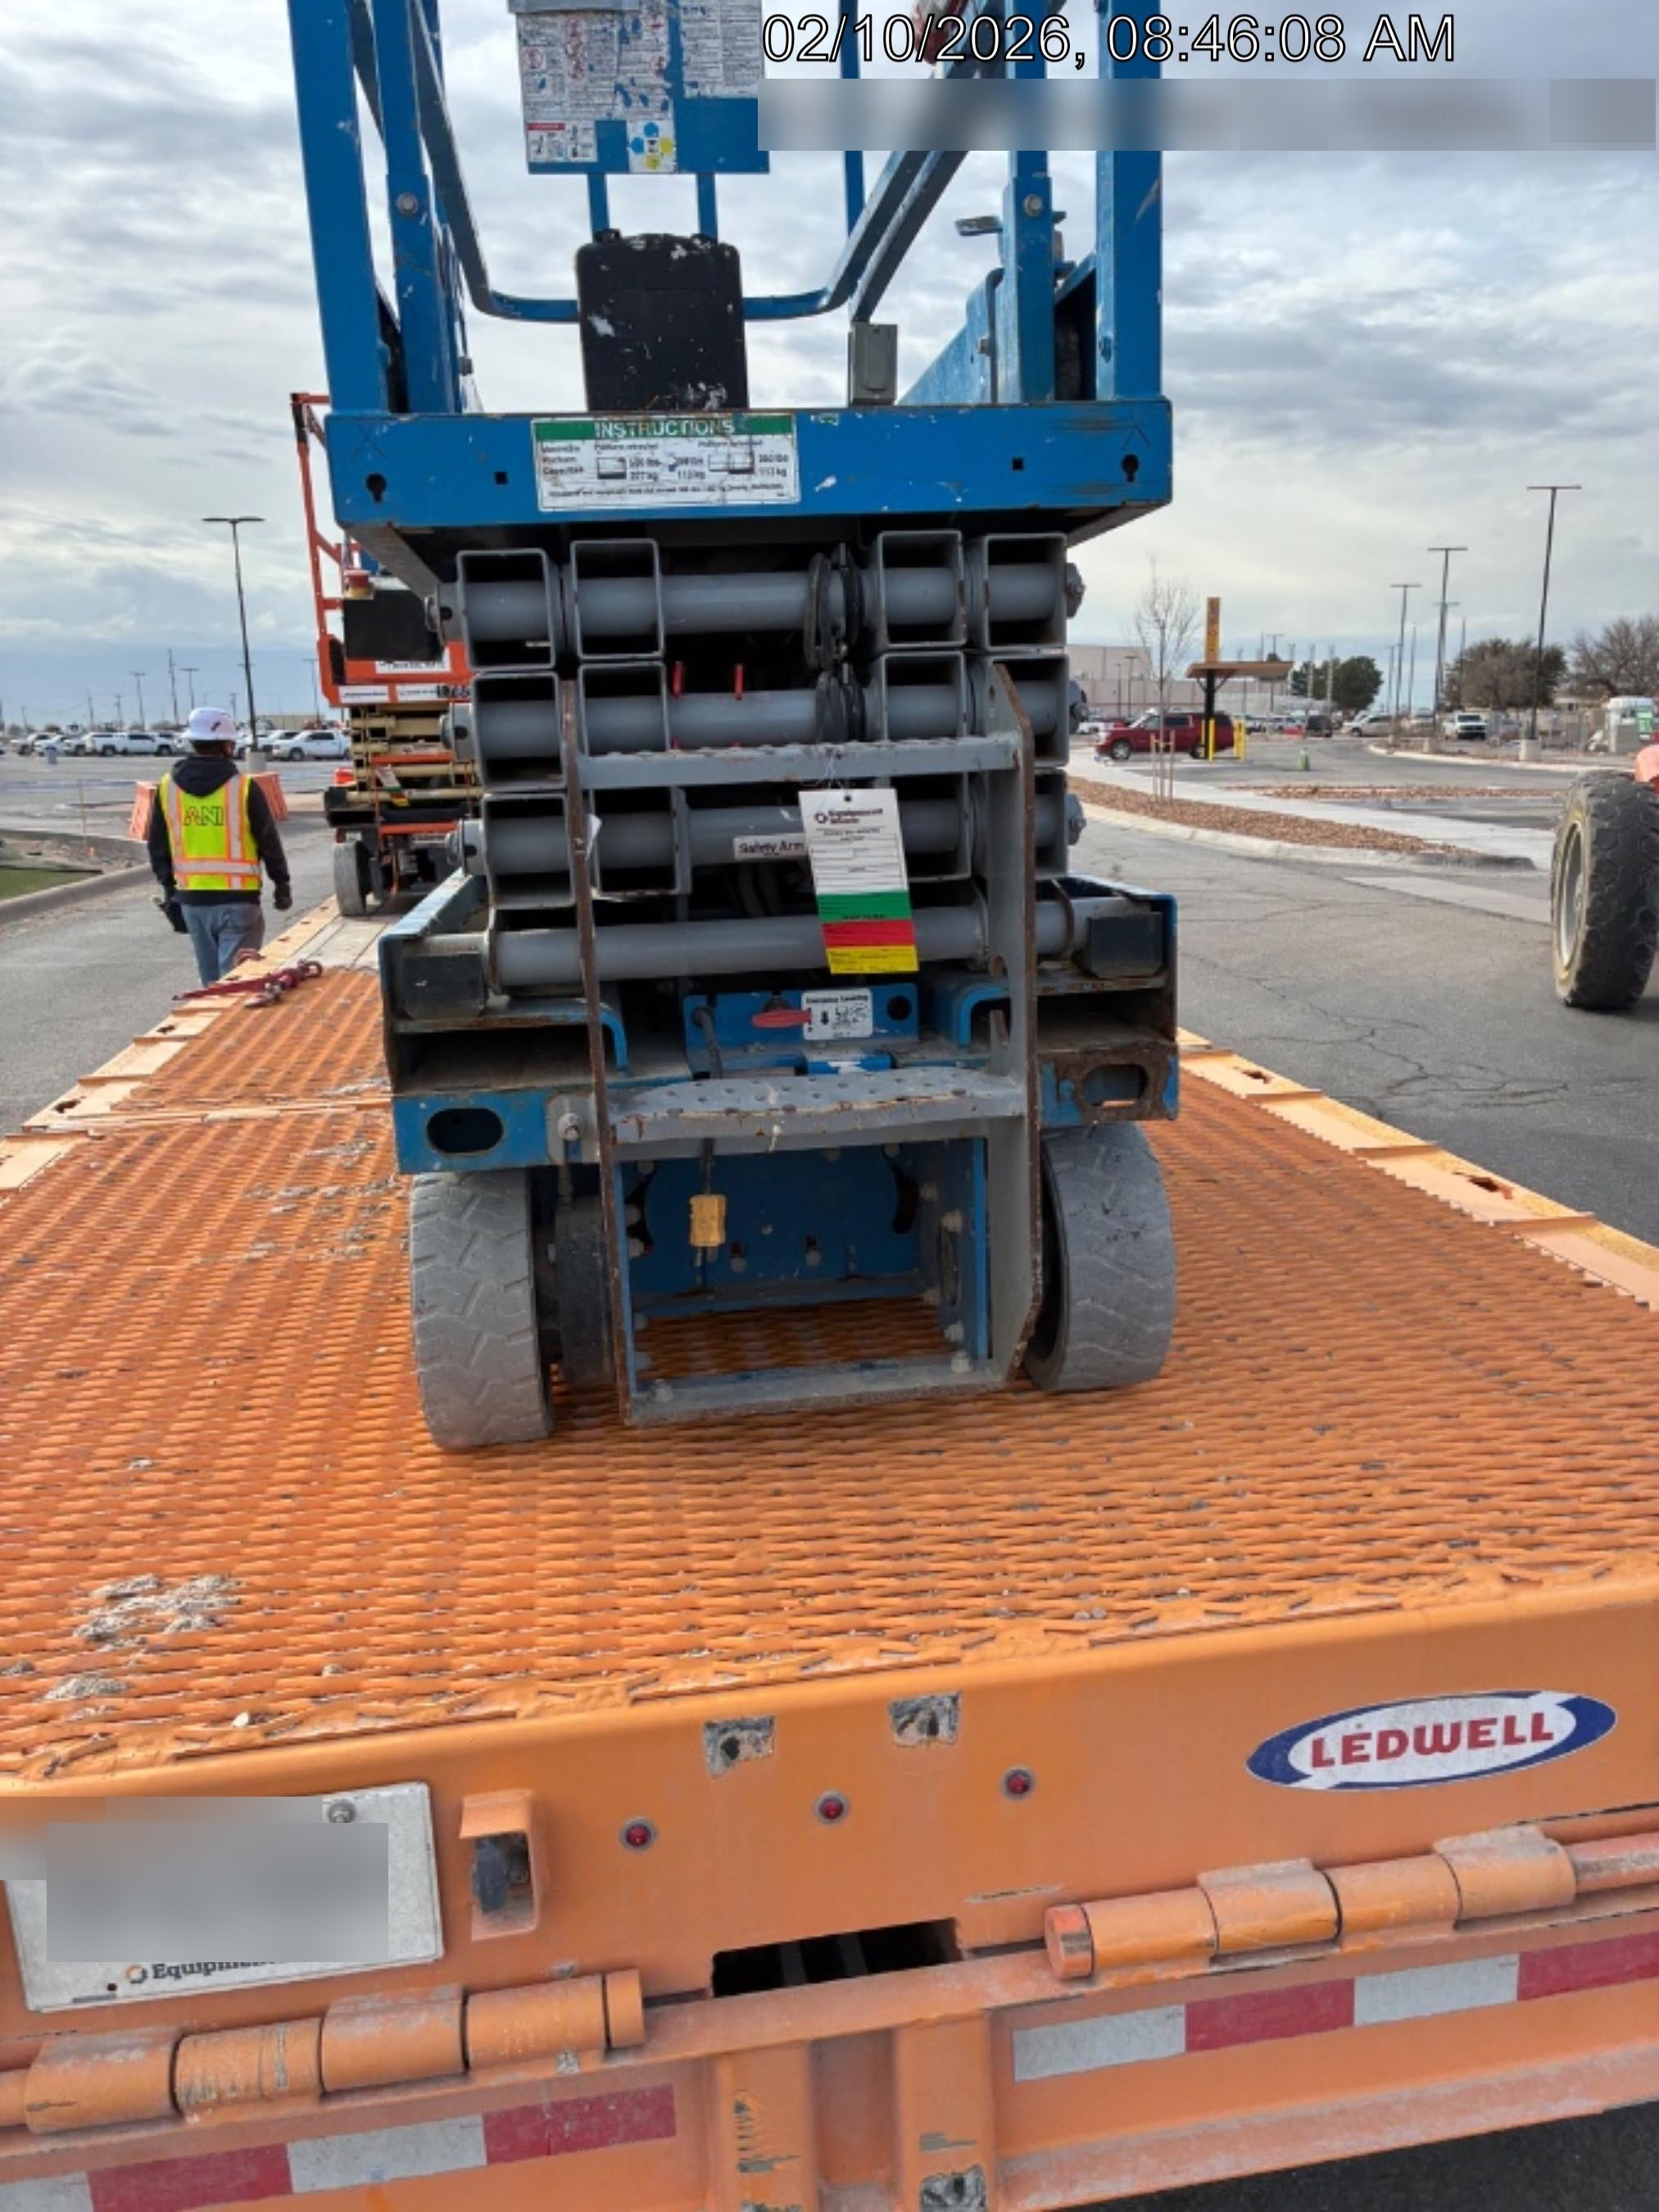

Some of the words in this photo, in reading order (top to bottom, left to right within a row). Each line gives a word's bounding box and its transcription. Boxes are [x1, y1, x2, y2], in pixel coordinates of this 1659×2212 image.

[595, 419, 736, 438] INSTRUCTIONS
[739, 839, 777, 854] Safety
[1311, 1711, 1555, 1769] LEDWELL
